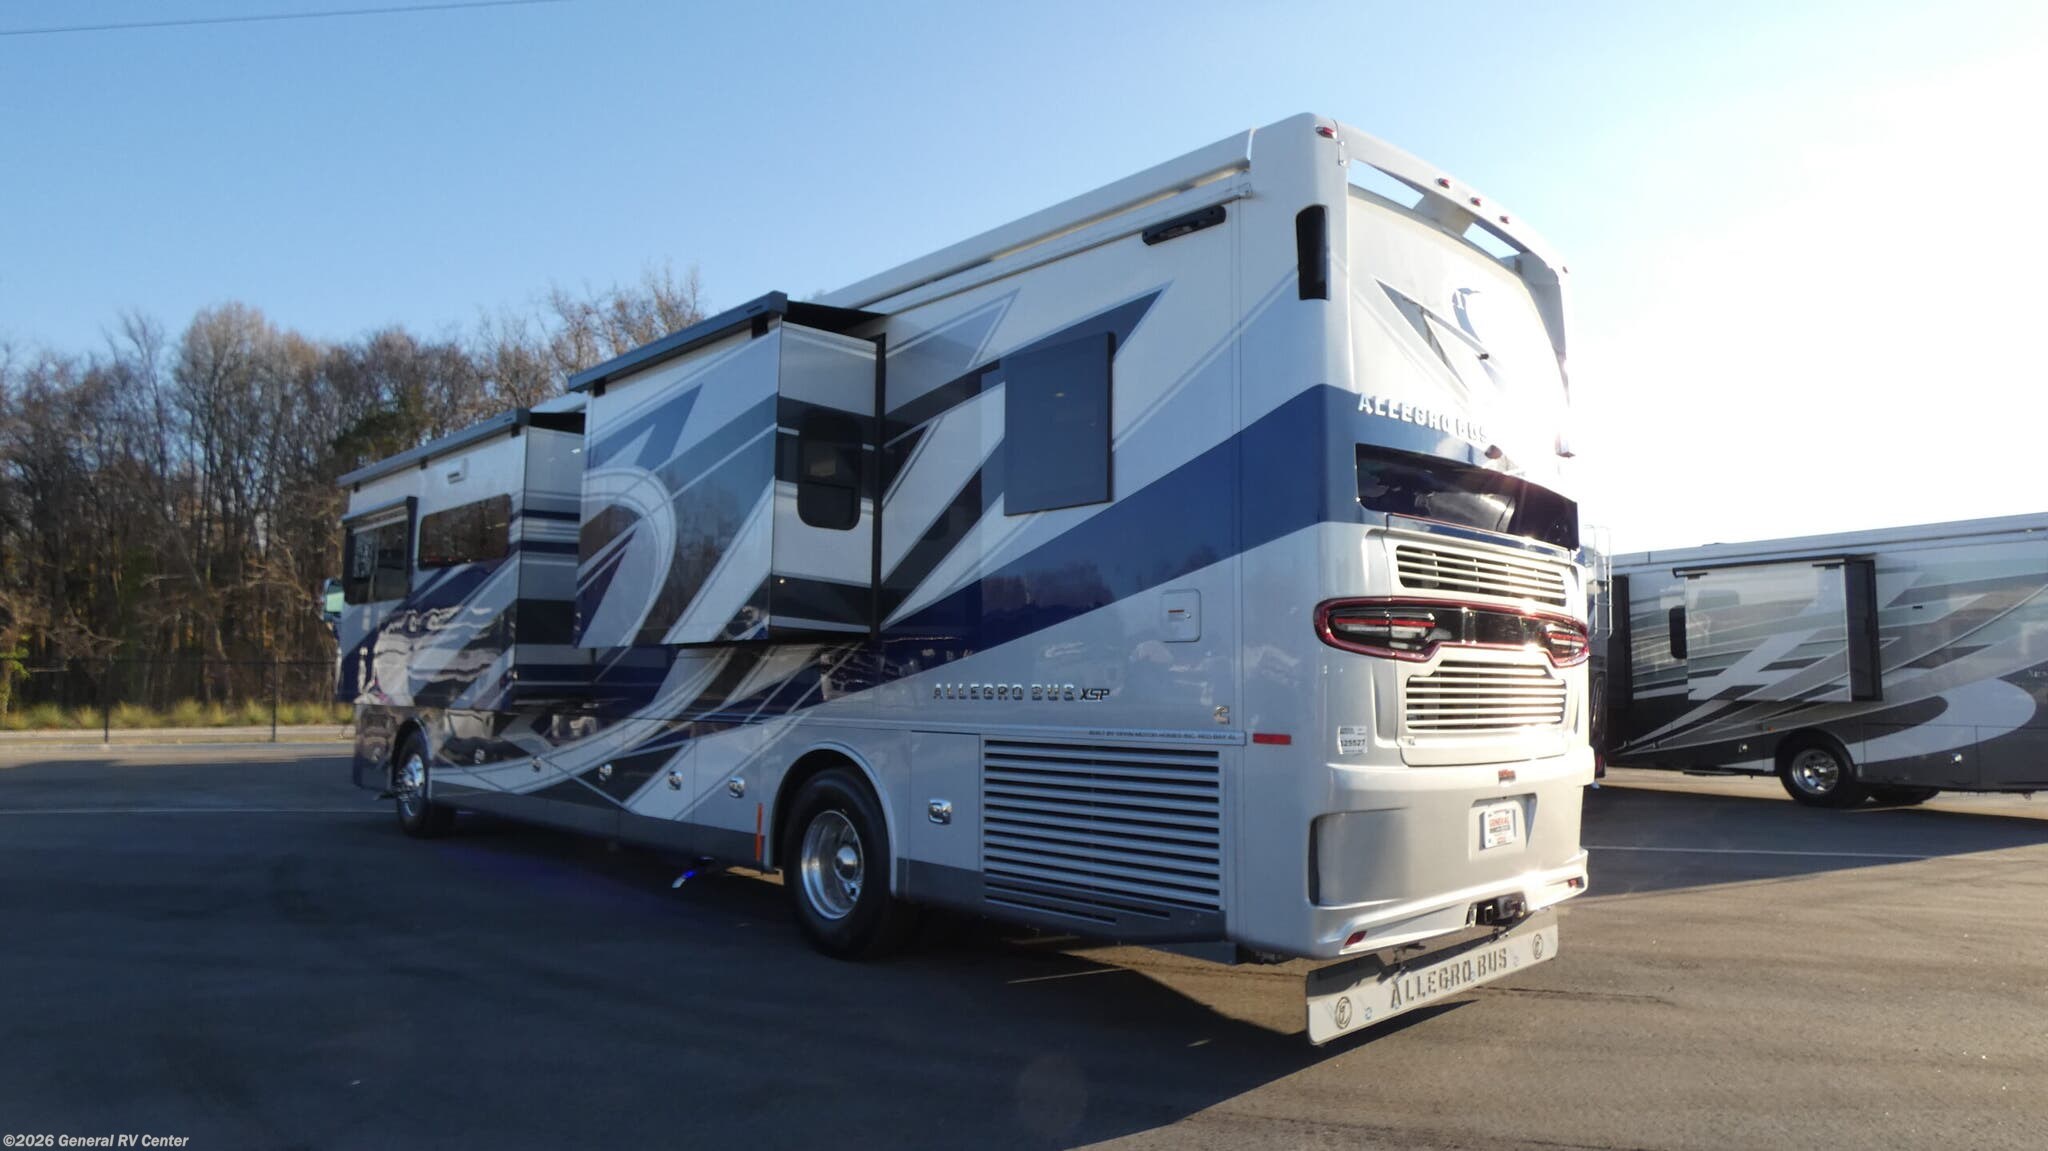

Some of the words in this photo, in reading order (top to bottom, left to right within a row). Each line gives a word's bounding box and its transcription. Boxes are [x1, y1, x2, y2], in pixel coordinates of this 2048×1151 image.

[1357, 393, 1449, 433] ALLEGRO
[933, 683, 1024, 701] ALLEGRO
[1031, 683, 1075, 701] BUS
[1079, 687, 1110, 701] XSP
[1391, 960, 1472, 1008] ALLEGRO
[1477, 948, 1507, 978] BUS
